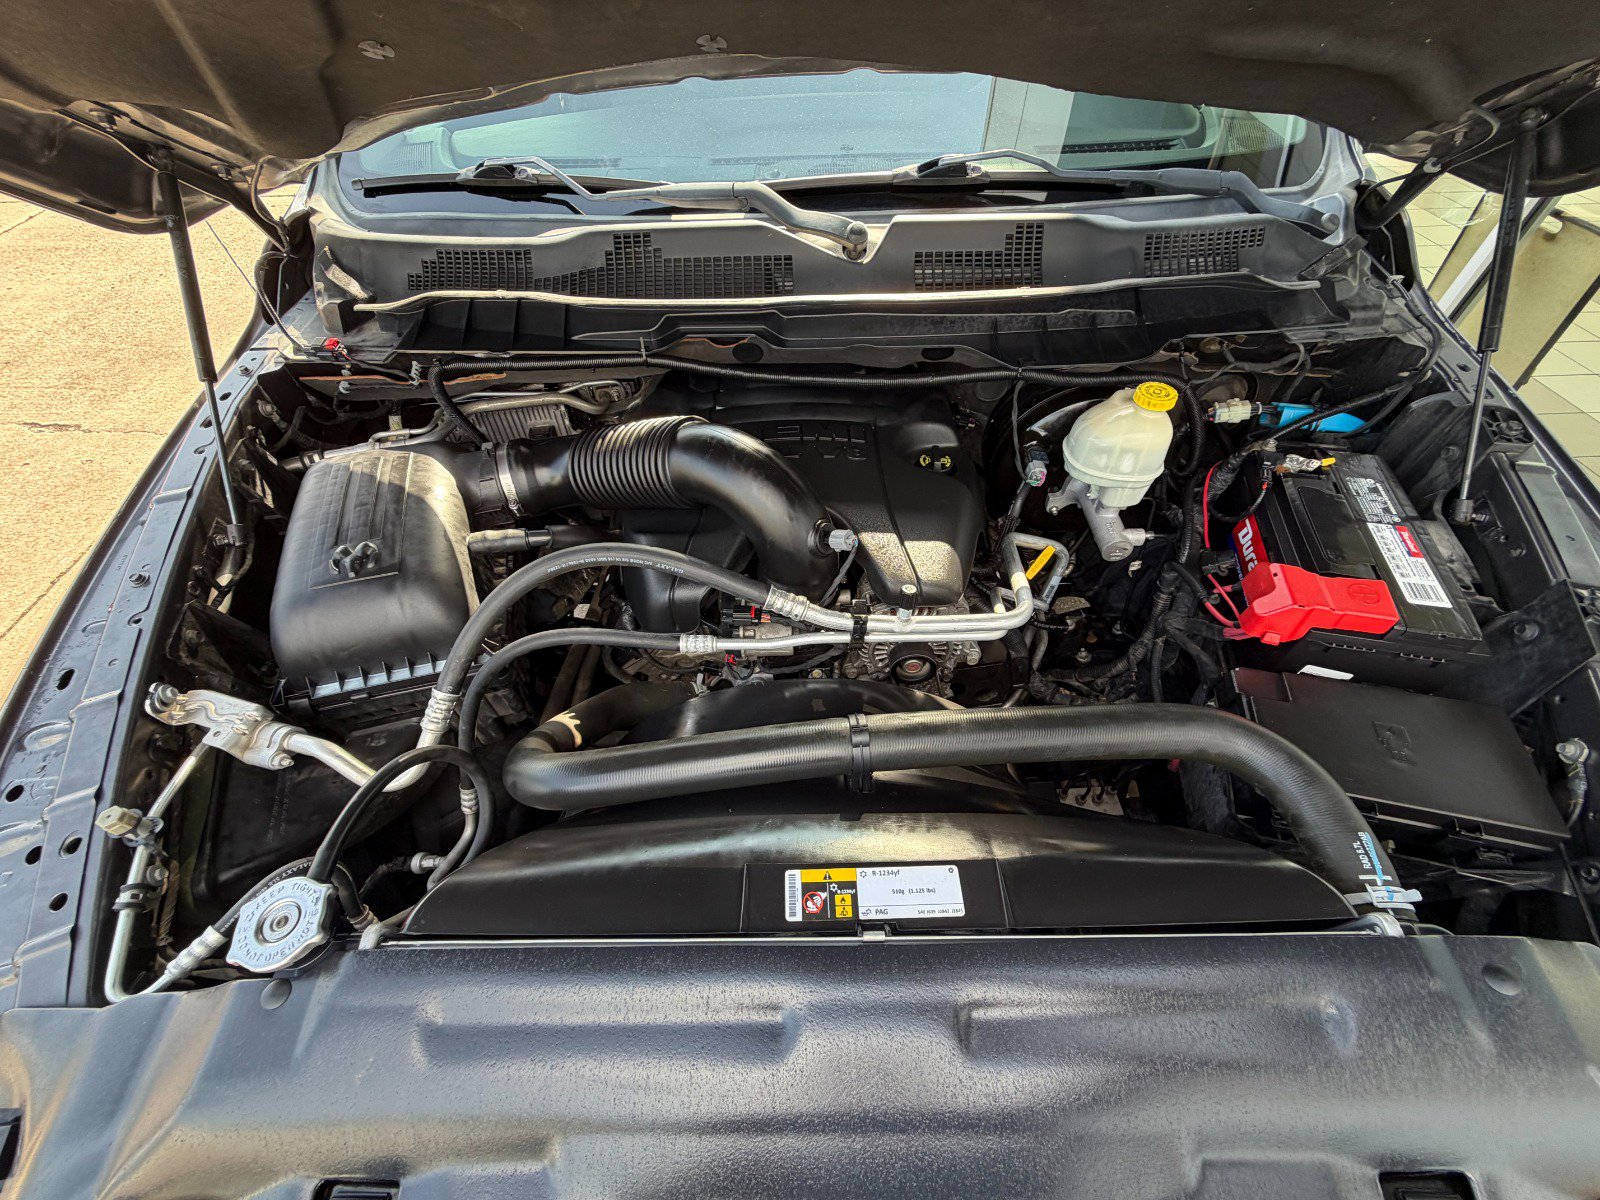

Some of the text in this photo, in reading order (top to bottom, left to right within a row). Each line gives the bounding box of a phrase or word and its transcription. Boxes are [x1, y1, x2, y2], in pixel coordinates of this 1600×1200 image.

[656, 563, 684, 574] GALAXY
[1359, 854, 1372, 869] RAD
[872, 869, 900, 878] R-1234yf
[891, 888, 905, 896] 510g
[908, 887, 925, 895] (1.125
[255, 886, 285, 910] KEEP
[875, 908, 889, 916] PAG
